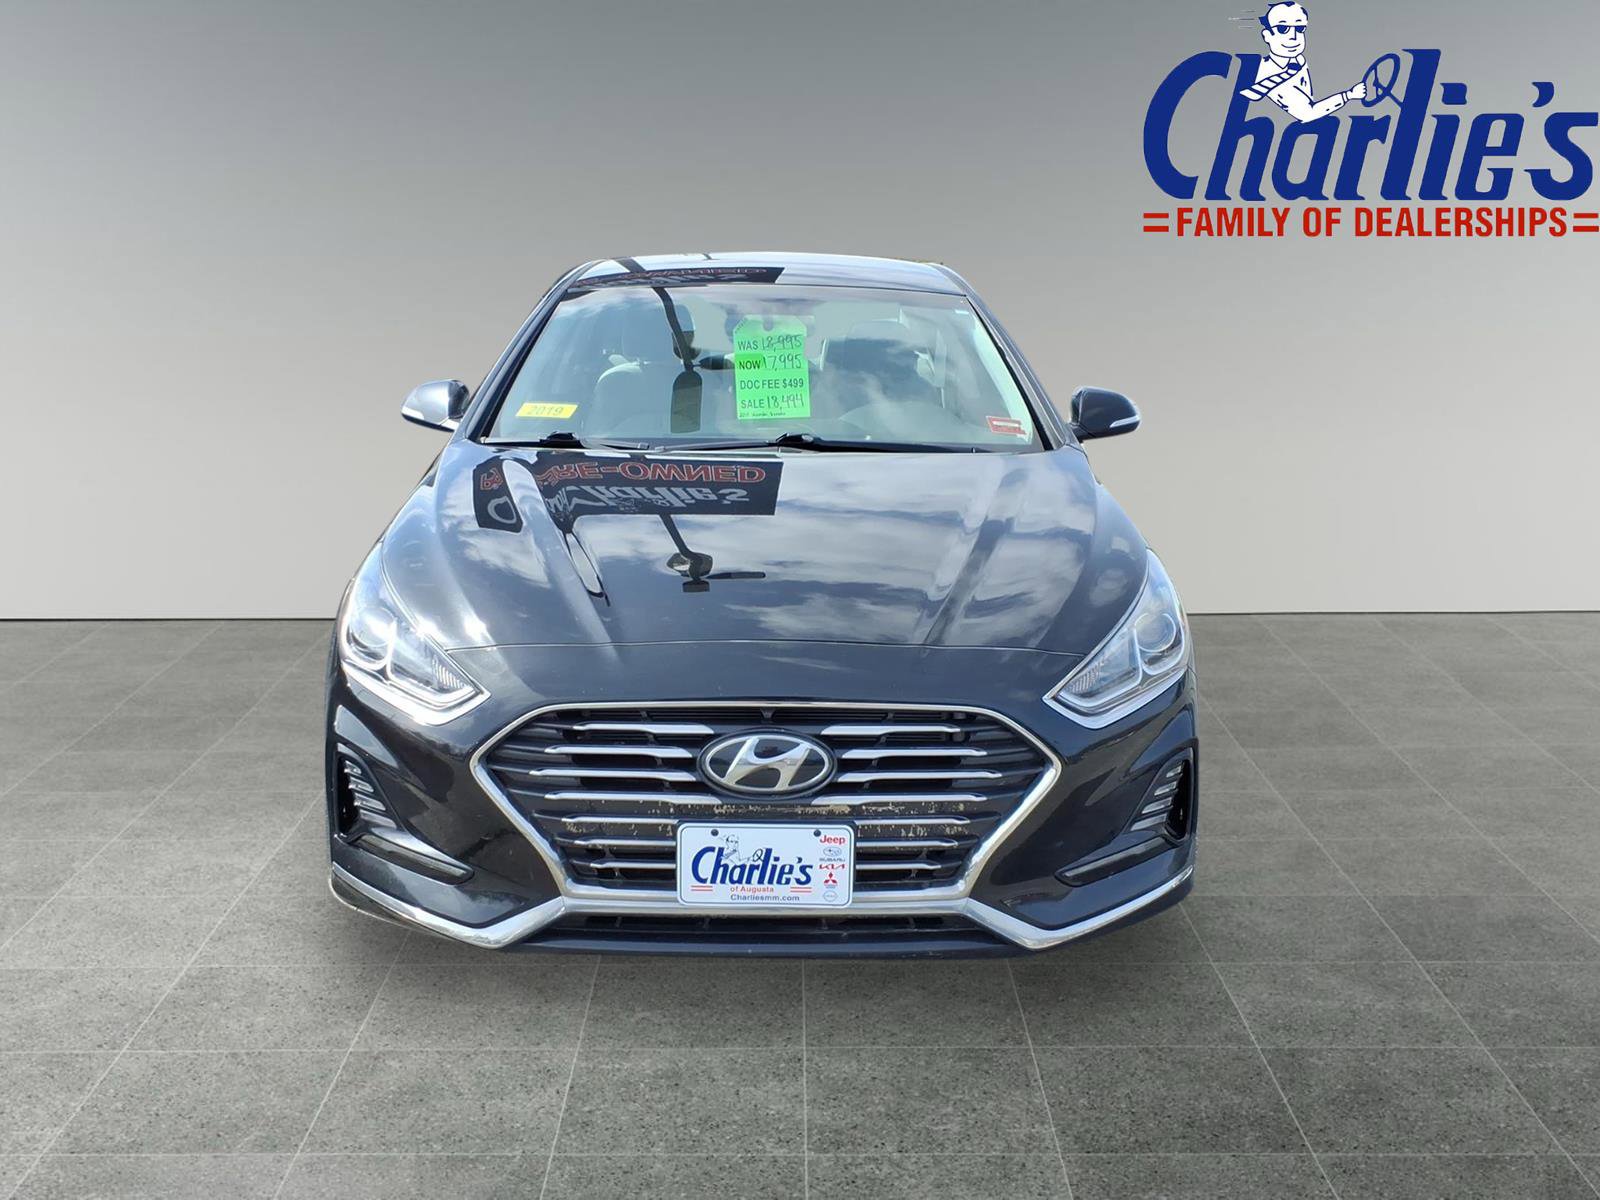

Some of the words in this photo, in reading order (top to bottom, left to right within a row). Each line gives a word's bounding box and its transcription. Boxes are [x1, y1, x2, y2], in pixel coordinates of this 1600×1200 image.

[738, 340, 758, 350] WAS
[739, 360, 760, 370] NOW
[761, 354, 802, 371] 17,995
[740, 380, 760, 389] DOC
[761, 379, 780, 389] FEE
[782, 378, 804, 389] $499
[741, 399, 765, 409] SALE
[819, 835, 846, 845] Jeep
[691, 846, 813, 886] Charlie's
